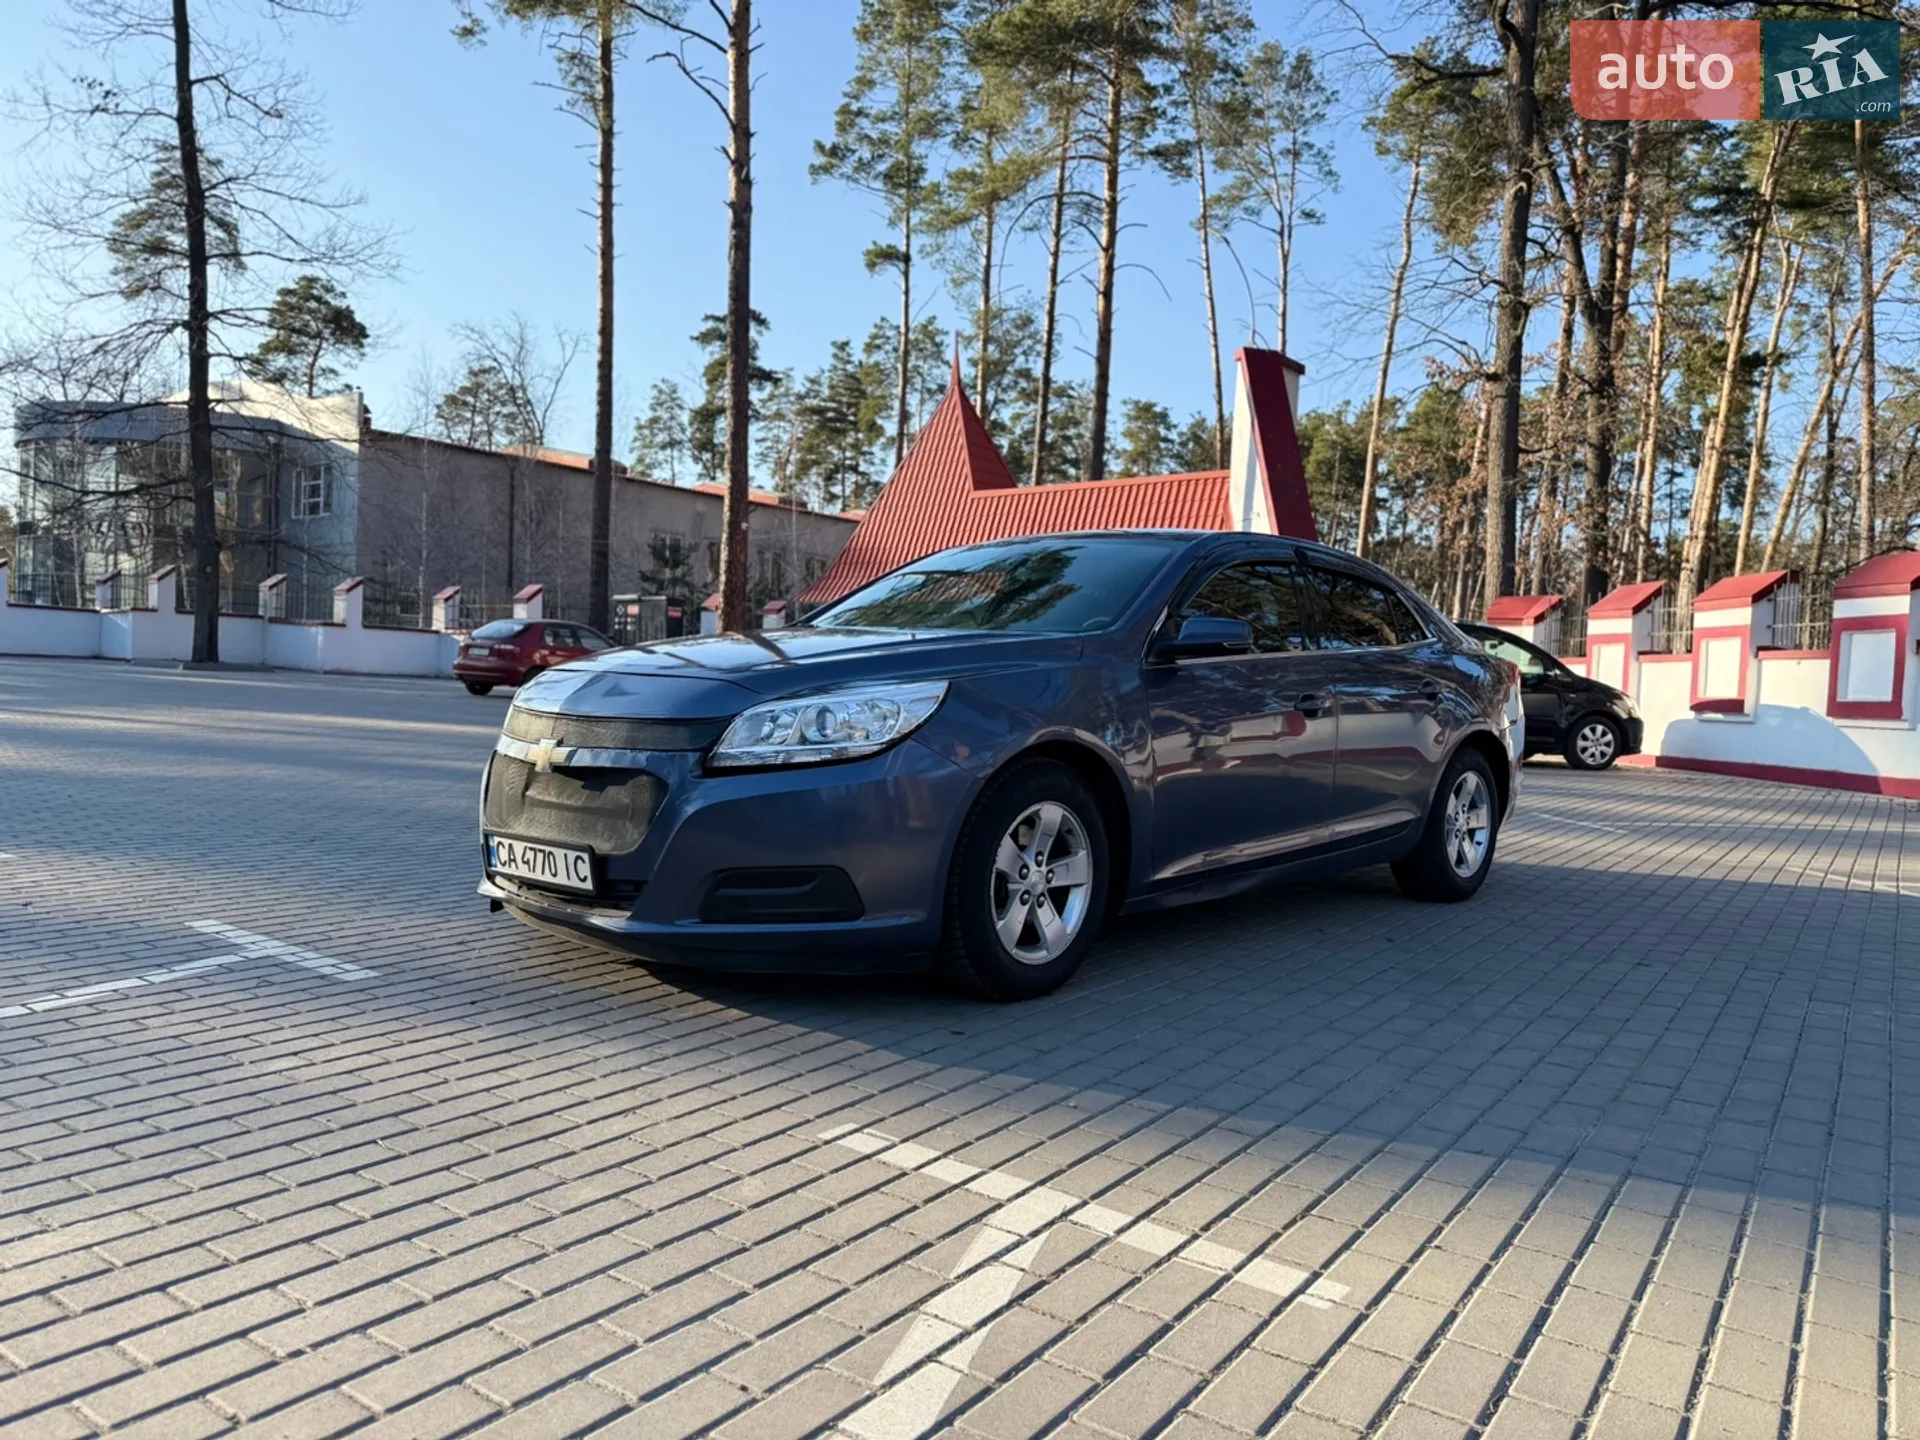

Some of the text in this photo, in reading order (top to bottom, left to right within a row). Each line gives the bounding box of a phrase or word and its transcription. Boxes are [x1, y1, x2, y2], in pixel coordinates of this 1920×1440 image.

[496, 841, 588, 883] CA 4770 IC
